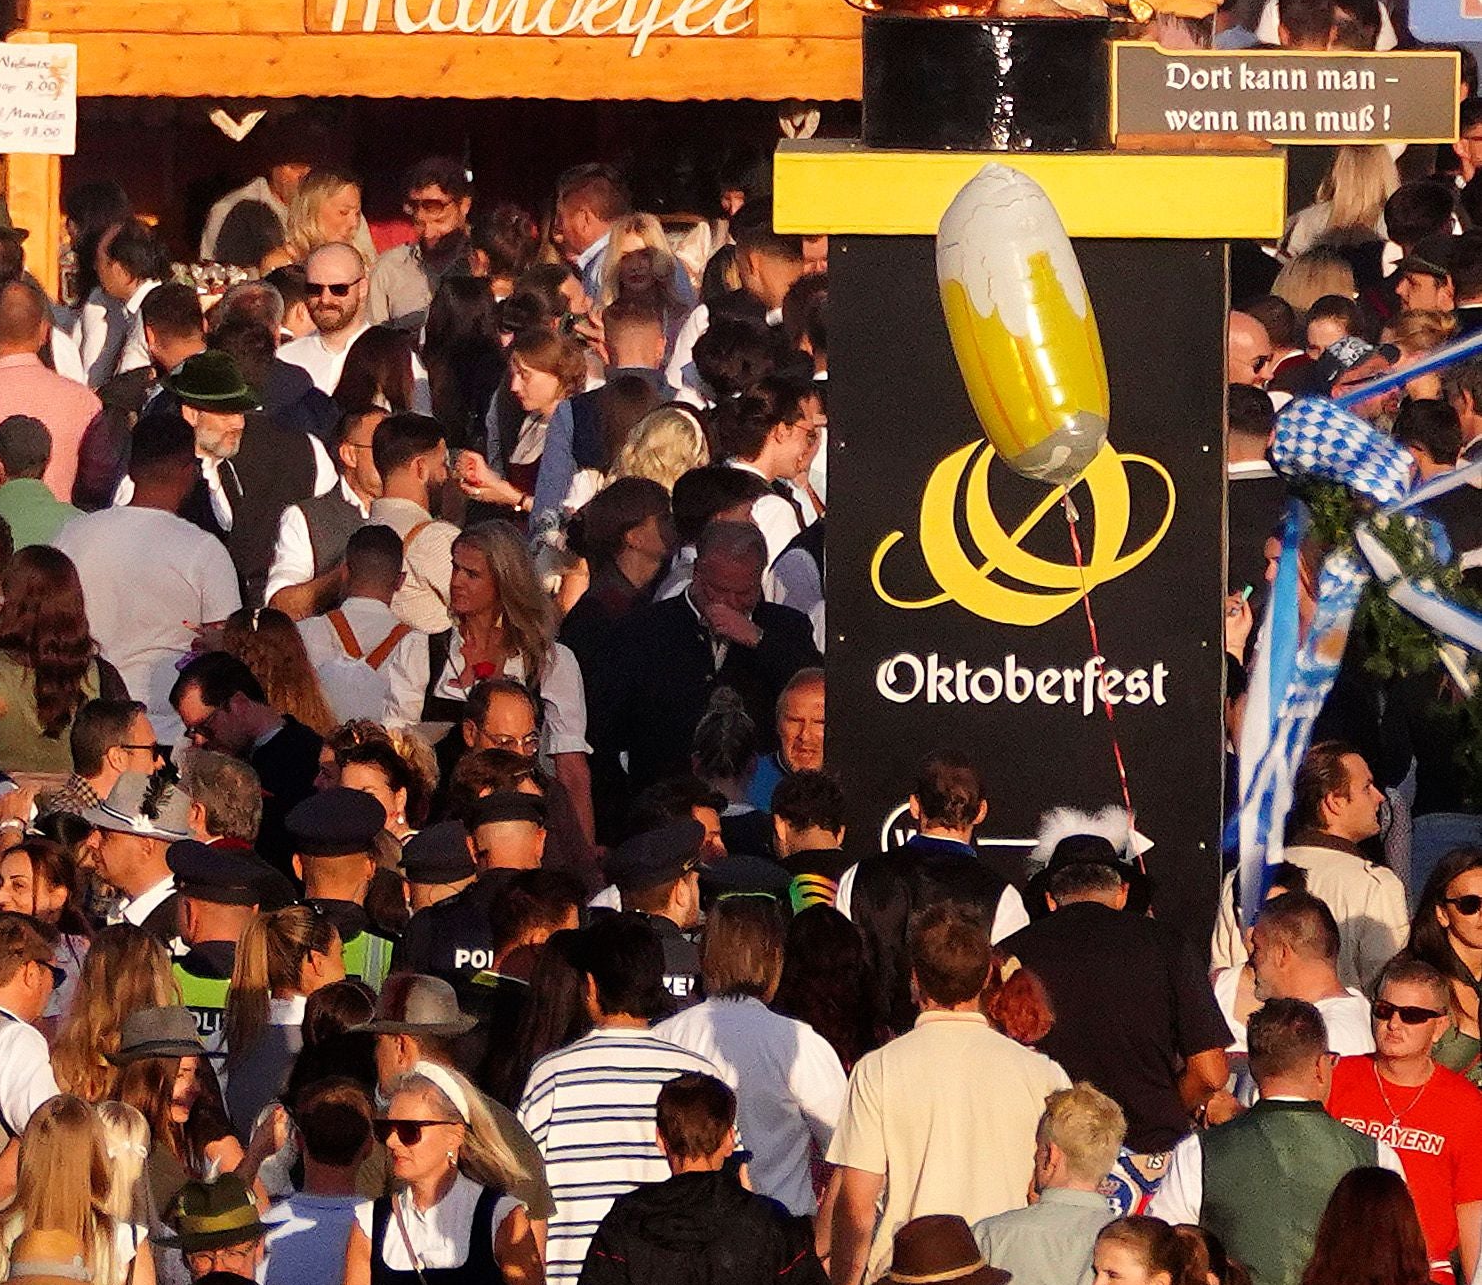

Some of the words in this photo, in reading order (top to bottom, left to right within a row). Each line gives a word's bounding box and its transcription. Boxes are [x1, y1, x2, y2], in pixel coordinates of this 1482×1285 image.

[1165, 61, 1232, 91] Dort
[1238, 61, 1308, 91] kann
[1317, 68, 1376, 91] man
[1164, 106, 1239, 132] wenn
[1247, 107, 1307, 132] man
[1315, 104, 1375, 133] muß
[875, 653, 1169, 716] Oktoberfest
[1366, 1119, 1446, 1156] BAYERN
